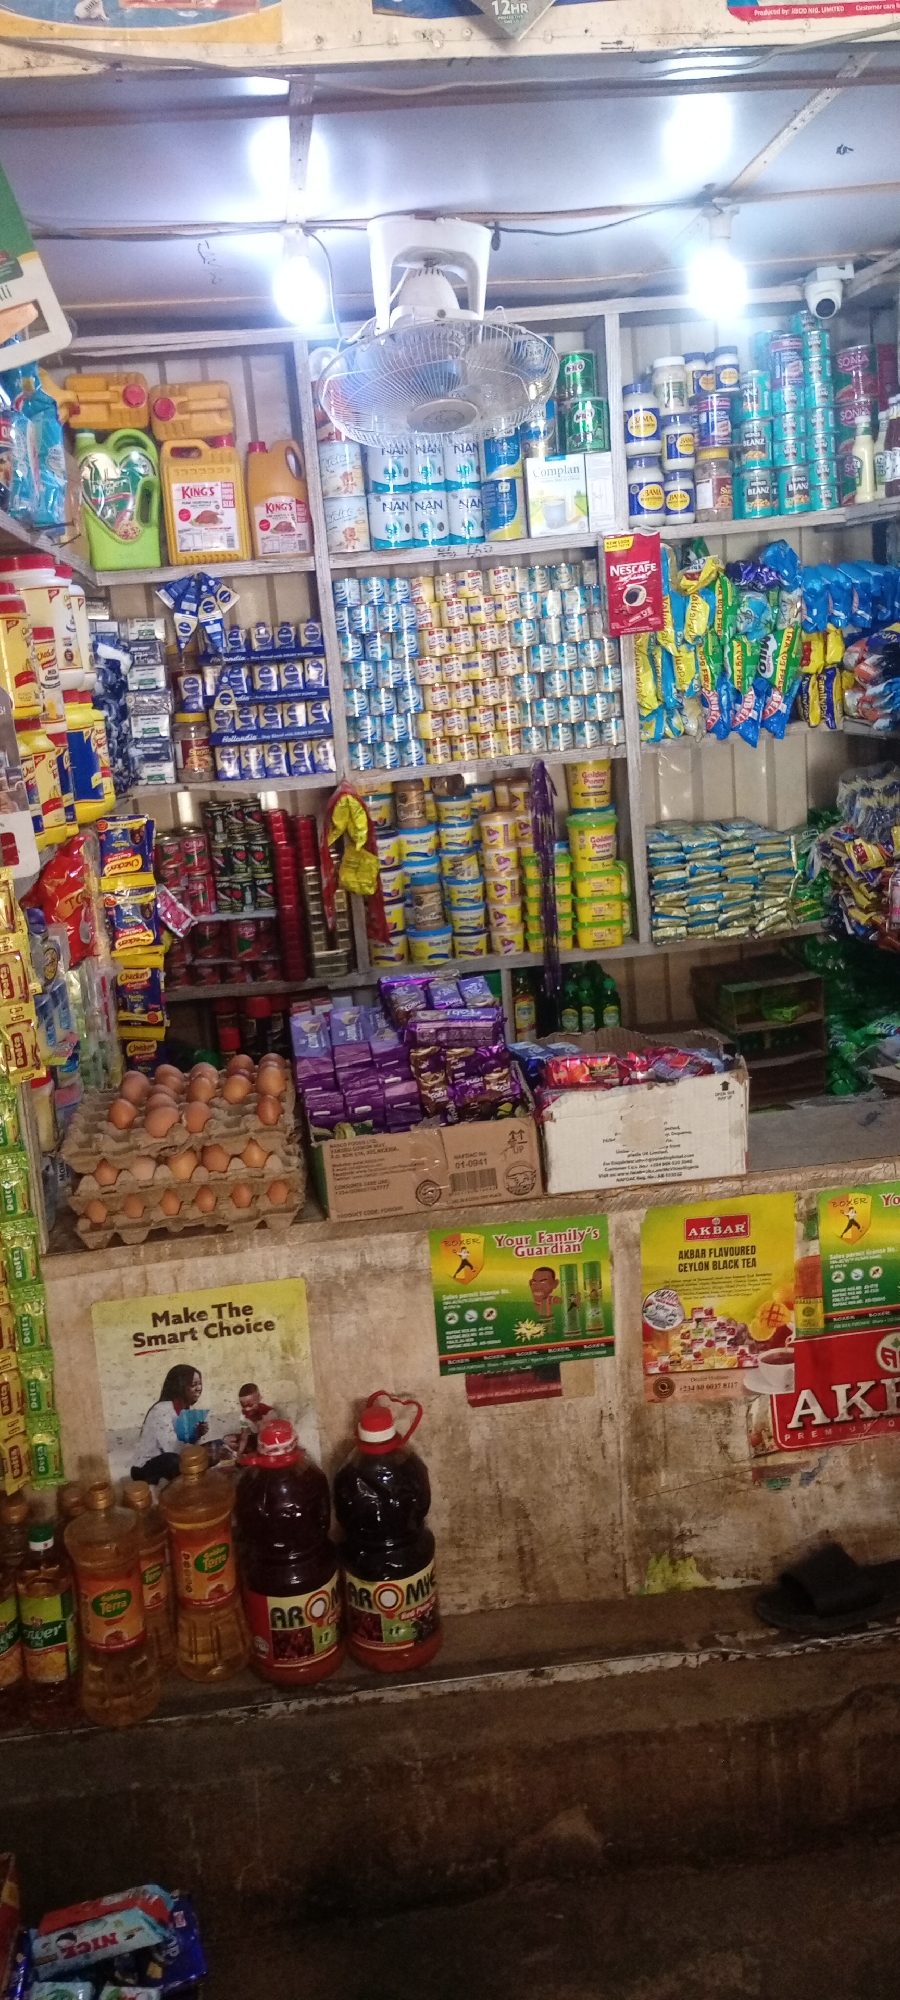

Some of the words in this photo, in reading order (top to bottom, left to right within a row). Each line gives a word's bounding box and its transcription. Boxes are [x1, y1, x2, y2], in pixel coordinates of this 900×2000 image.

[492, 0, 529, 15] 12HR
[754, 8, 780, 16] Produced
[632, 415, 654, 424] BAMA
[454, 442, 479, 454] NAN
[742, 439, 765, 447] BEANZ
[381, 447, 408, 456] NAN
[415, 444, 441, 455] NAN
[533, 465, 580, 478] Complan
[182, 486, 215, 499] KING'S
[747, 487, 769, 495] BEANZ
[265, 503, 293, 514] KING'S
[382, 501, 409, 512] NAN
[415, 500, 443, 511] NAN
[759, 634, 772, 674] MILO
[221, 734, 258, 743] Hollandia
[582, 771, 607, 781] Golden
[584, 778, 606, 787] Penny
[590, 836, 614, 846] Golden
[592, 842, 612, 851] Penny
[106, 858, 140, 873] Checkers
[120, 971, 149, 981] Checkers
[13, 1035, 24, 1066] Delta
[513, 1145, 524, 1154] UP
[455, 1158, 488, 1169] 01-0941
[832, 1198, 868, 1208] BOXER
[688, 1222, 746, 1237] AKBAR
[443, 1236, 481, 1247] BOXER
[493, 1233, 532, 1249] Your
[537, 1226, 600, 1245] Family's
[514, 1241, 583, 1258] Guardian
[678, 1248, 706, 1260] AKBAR
[708, 1245, 757, 1258] FLAVOURED
[845, 1251, 865, 1259] permit
[13, 1248, 23, 1279] Delta
[678, 1260, 710, 1273] CEYLON
[712, 1258, 740, 1271] BLACK
[741, 1257, 757, 1269] TEA
[151, 1306, 208, 1328] Make
[211, 1301, 254, 1320] The
[23, 1316, 31, 1344] Delta
[132, 1327, 198, 1349] Smart
[204, 1318, 276, 1340] Choice
[30, 1381, 38, 1410] Delta
[11, 1447, 20, 1479] Delta
[38, 1445, 46, 1473] Delta
[204, 1547, 227, 1559] Golden
[202, 1553, 228, 1571] Terra
[144, 1570, 163, 1584] Terra
[101, 1592, 128, 1600] Golden
[99, 1599, 128, 1614] Terra
